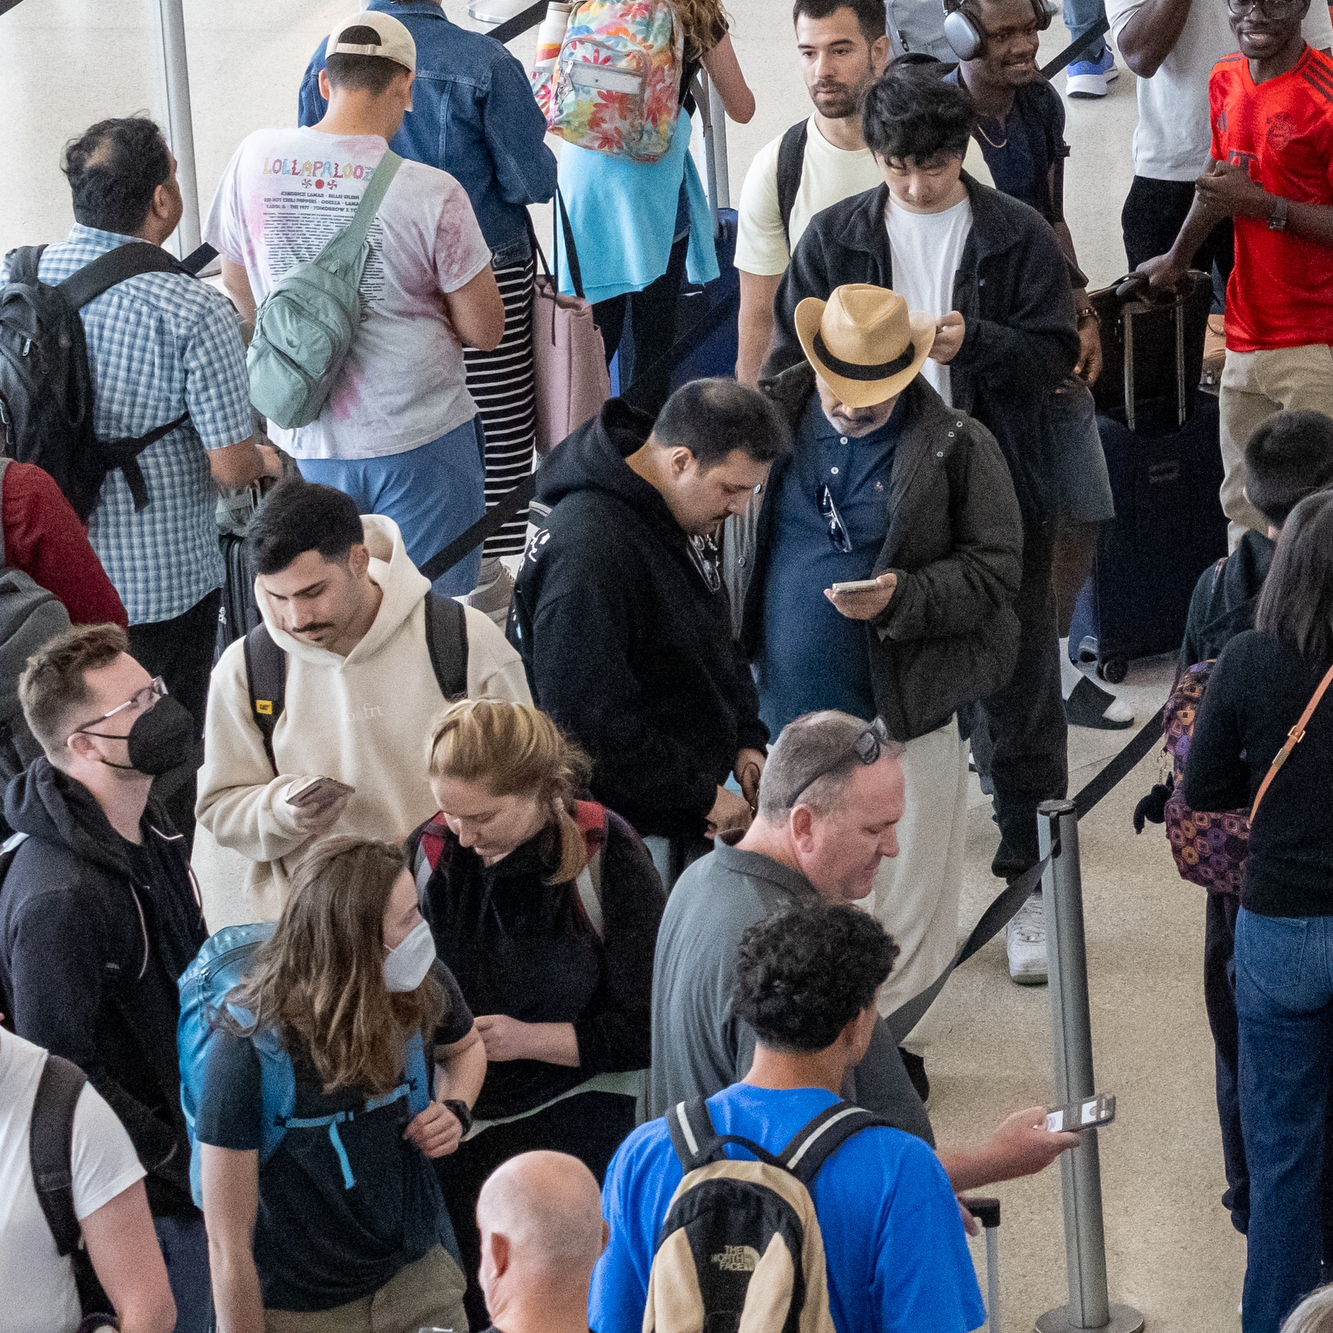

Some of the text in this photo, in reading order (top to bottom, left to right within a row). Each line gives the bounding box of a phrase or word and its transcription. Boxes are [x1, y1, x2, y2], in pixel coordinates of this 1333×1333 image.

[263, 157, 375, 182] LOLLAPALOOZ
[724, 1245, 745, 1254] THE
[711, 1253, 744, 1264] NORTH
[720, 1262, 745, 1271] FACE
